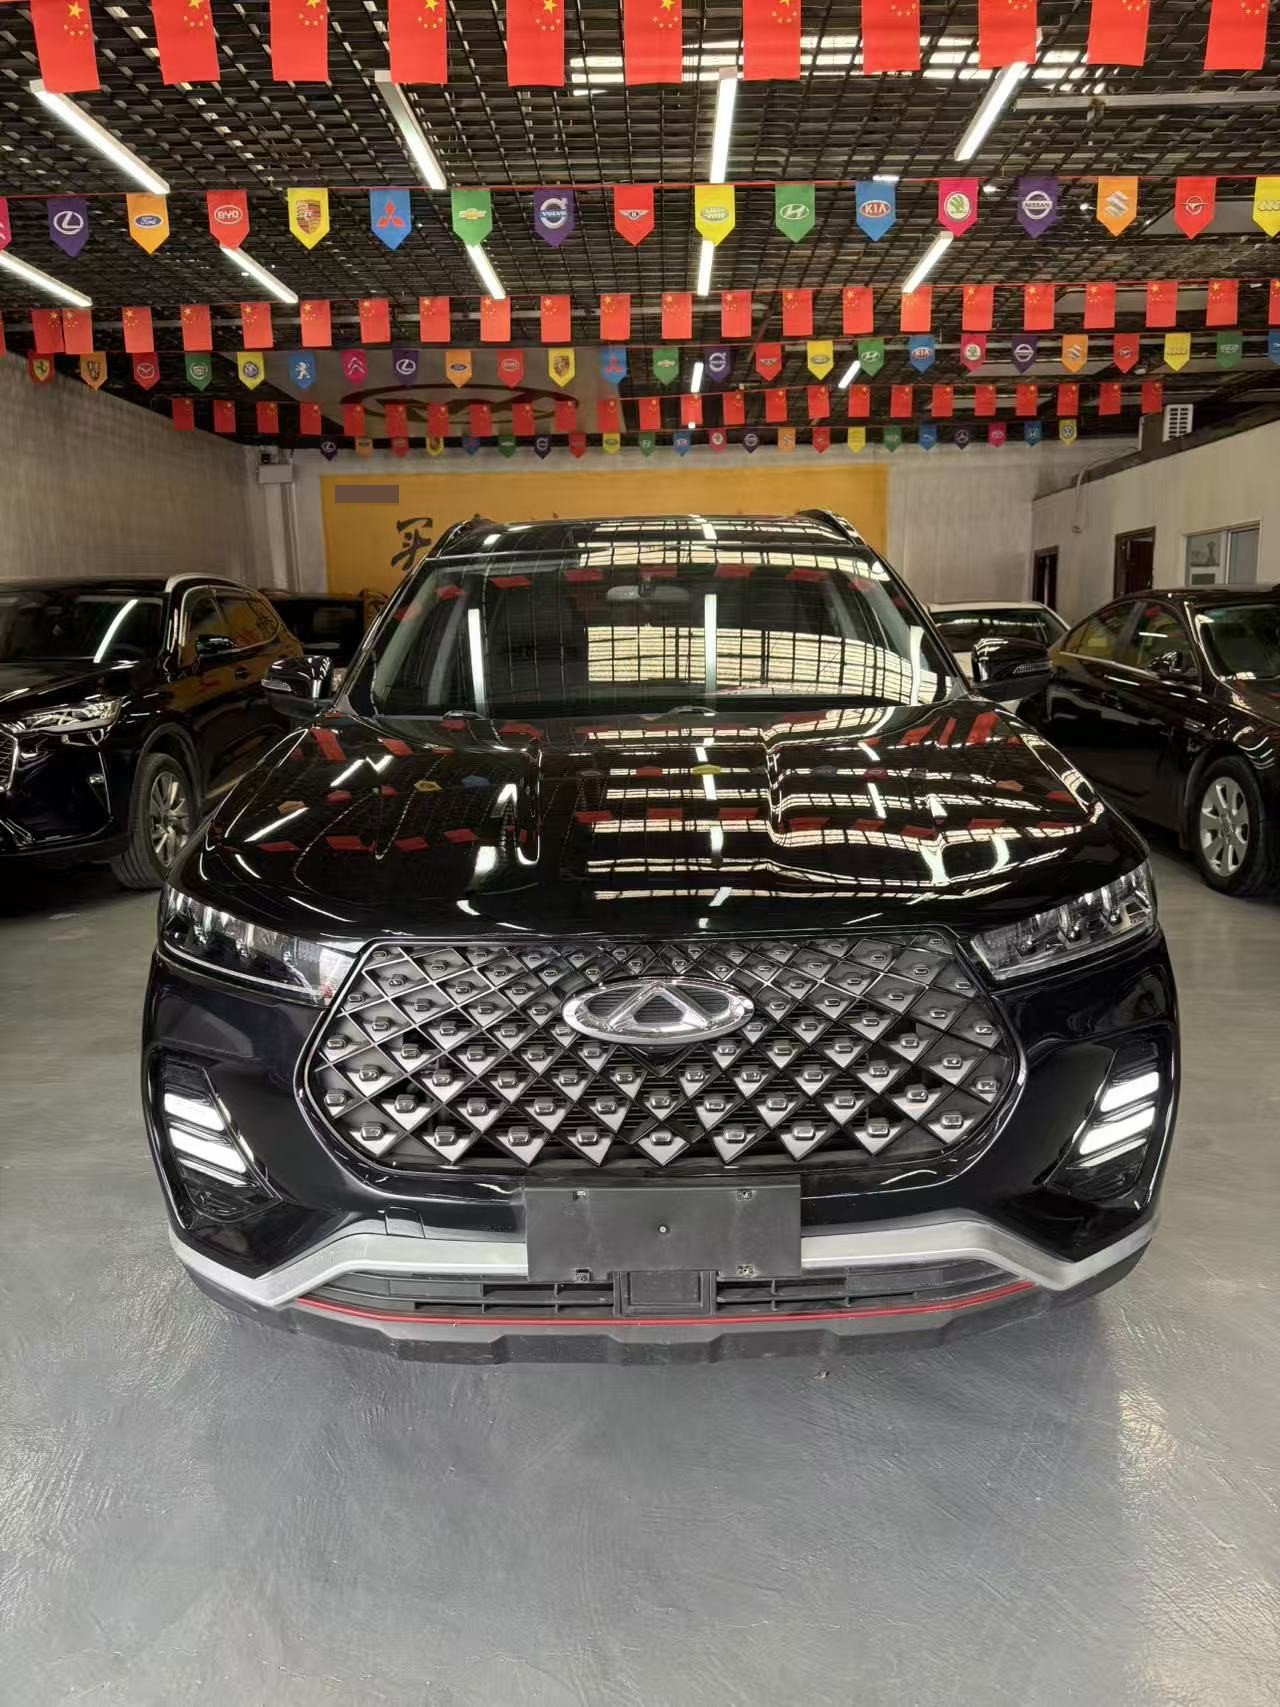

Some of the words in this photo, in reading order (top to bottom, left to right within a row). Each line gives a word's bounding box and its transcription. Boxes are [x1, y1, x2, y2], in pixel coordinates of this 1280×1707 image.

[865, 204, 887, 213] KIA
[217, 210, 239, 219] BYD
[140, 216, 156, 225] Ford
[391, 517, 433, 571] 买
